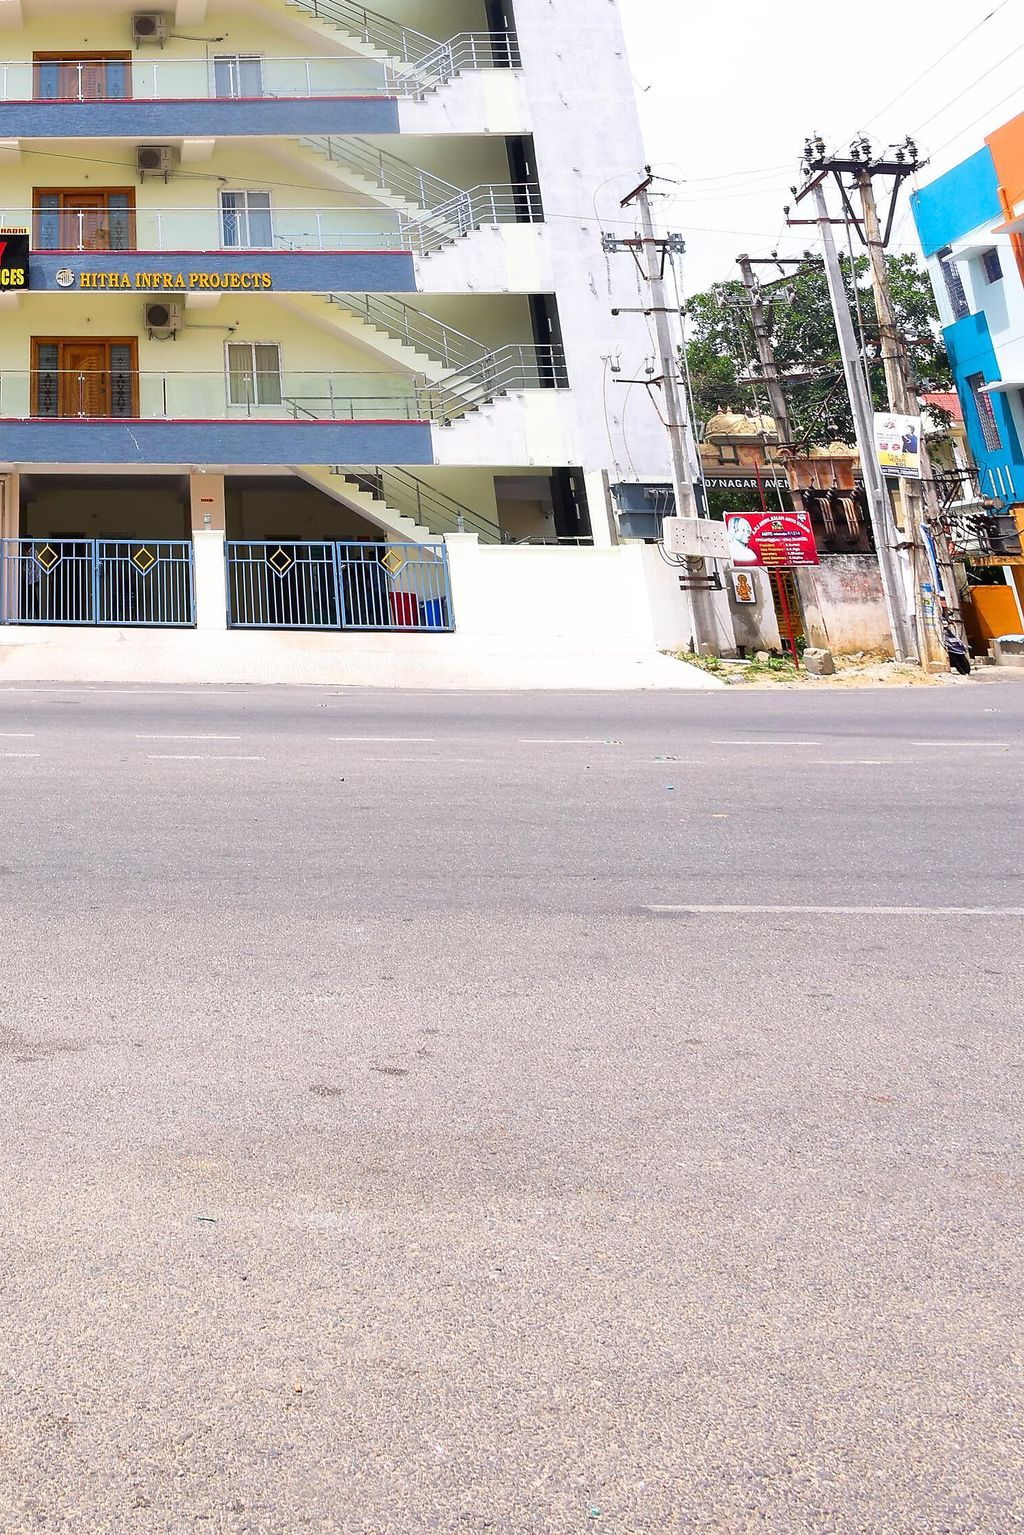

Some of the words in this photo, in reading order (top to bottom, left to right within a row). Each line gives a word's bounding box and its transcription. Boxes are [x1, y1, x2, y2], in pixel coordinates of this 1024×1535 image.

[79, 272, 132, 288] HITHA
[135, 272, 186, 288] INFRA
[189, 272, 272, 288] PROJECTS
